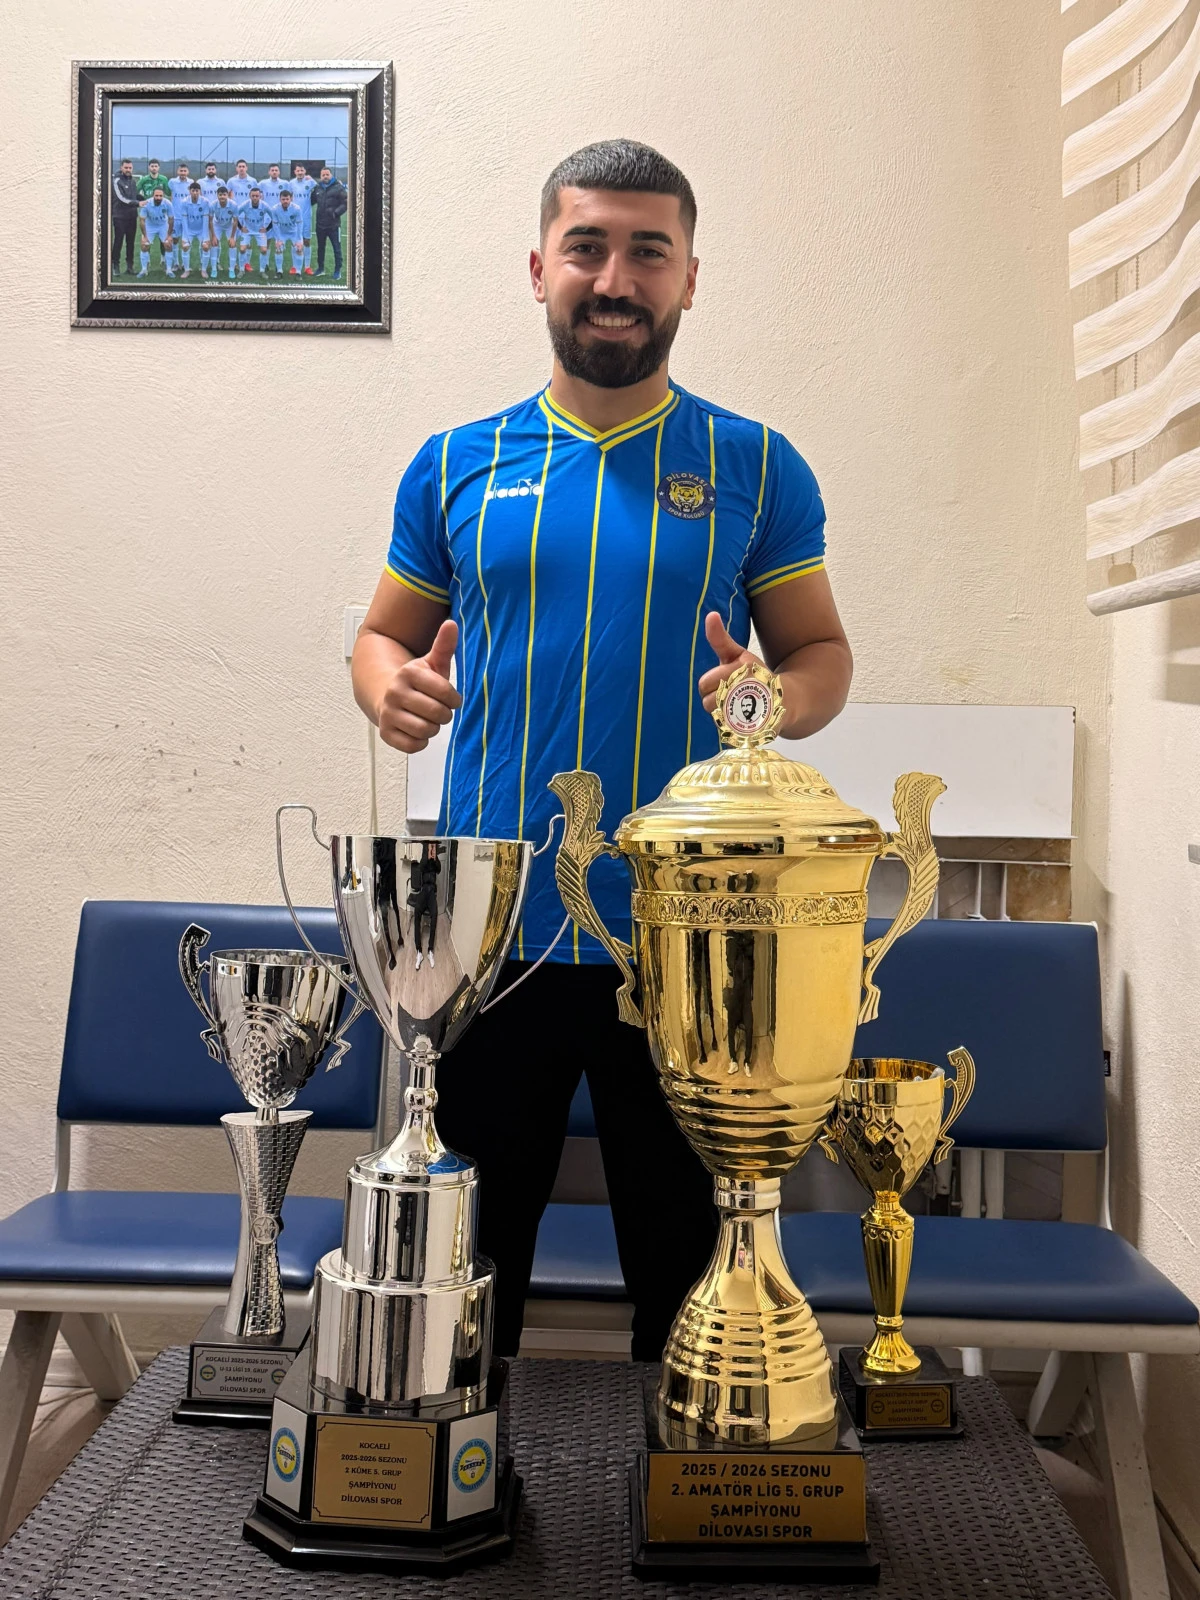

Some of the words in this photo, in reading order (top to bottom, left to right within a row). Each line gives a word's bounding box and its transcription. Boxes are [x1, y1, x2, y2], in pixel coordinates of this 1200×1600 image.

[224, 1375, 262, 1383] ŞAMPİYONU
[220, 1385, 248, 1393] DİLOVASI
[360, 1442, 390, 1450] KOCAELİ
[341, 1454, 377, 1462] 2025-2026
[378, 1456, 408, 1464] SEZONU
[351, 1466, 372, 1475] KÜME
[681, 1463, 716, 1476] 2025
[720, 1463, 728, 1477] /
[731, 1464, 766, 1477] 2026
[771, 1465, 831, 1477] SEZONU
[348, 1480, 397, 1490] ŞAMPİYONU
[671, 1484, 684, 1496] 2.
[688, 1481, 752, 1497] AMATÖR
[757, 1482, 781, 1497] LİG
[786, 1485, 798, 1497] 5.
[802, 1485, 844, 1498] GRUP
[341, 1494, 378, 1504] DİLOVASI
[380, 1497, 402, 1505] SPOR
[711, 1501, 801, 1519] ŞAMPİYONU
[699, 1522, 768, 1538] DİLOVASI
[772, 1525, 812, 1538] SPOR
